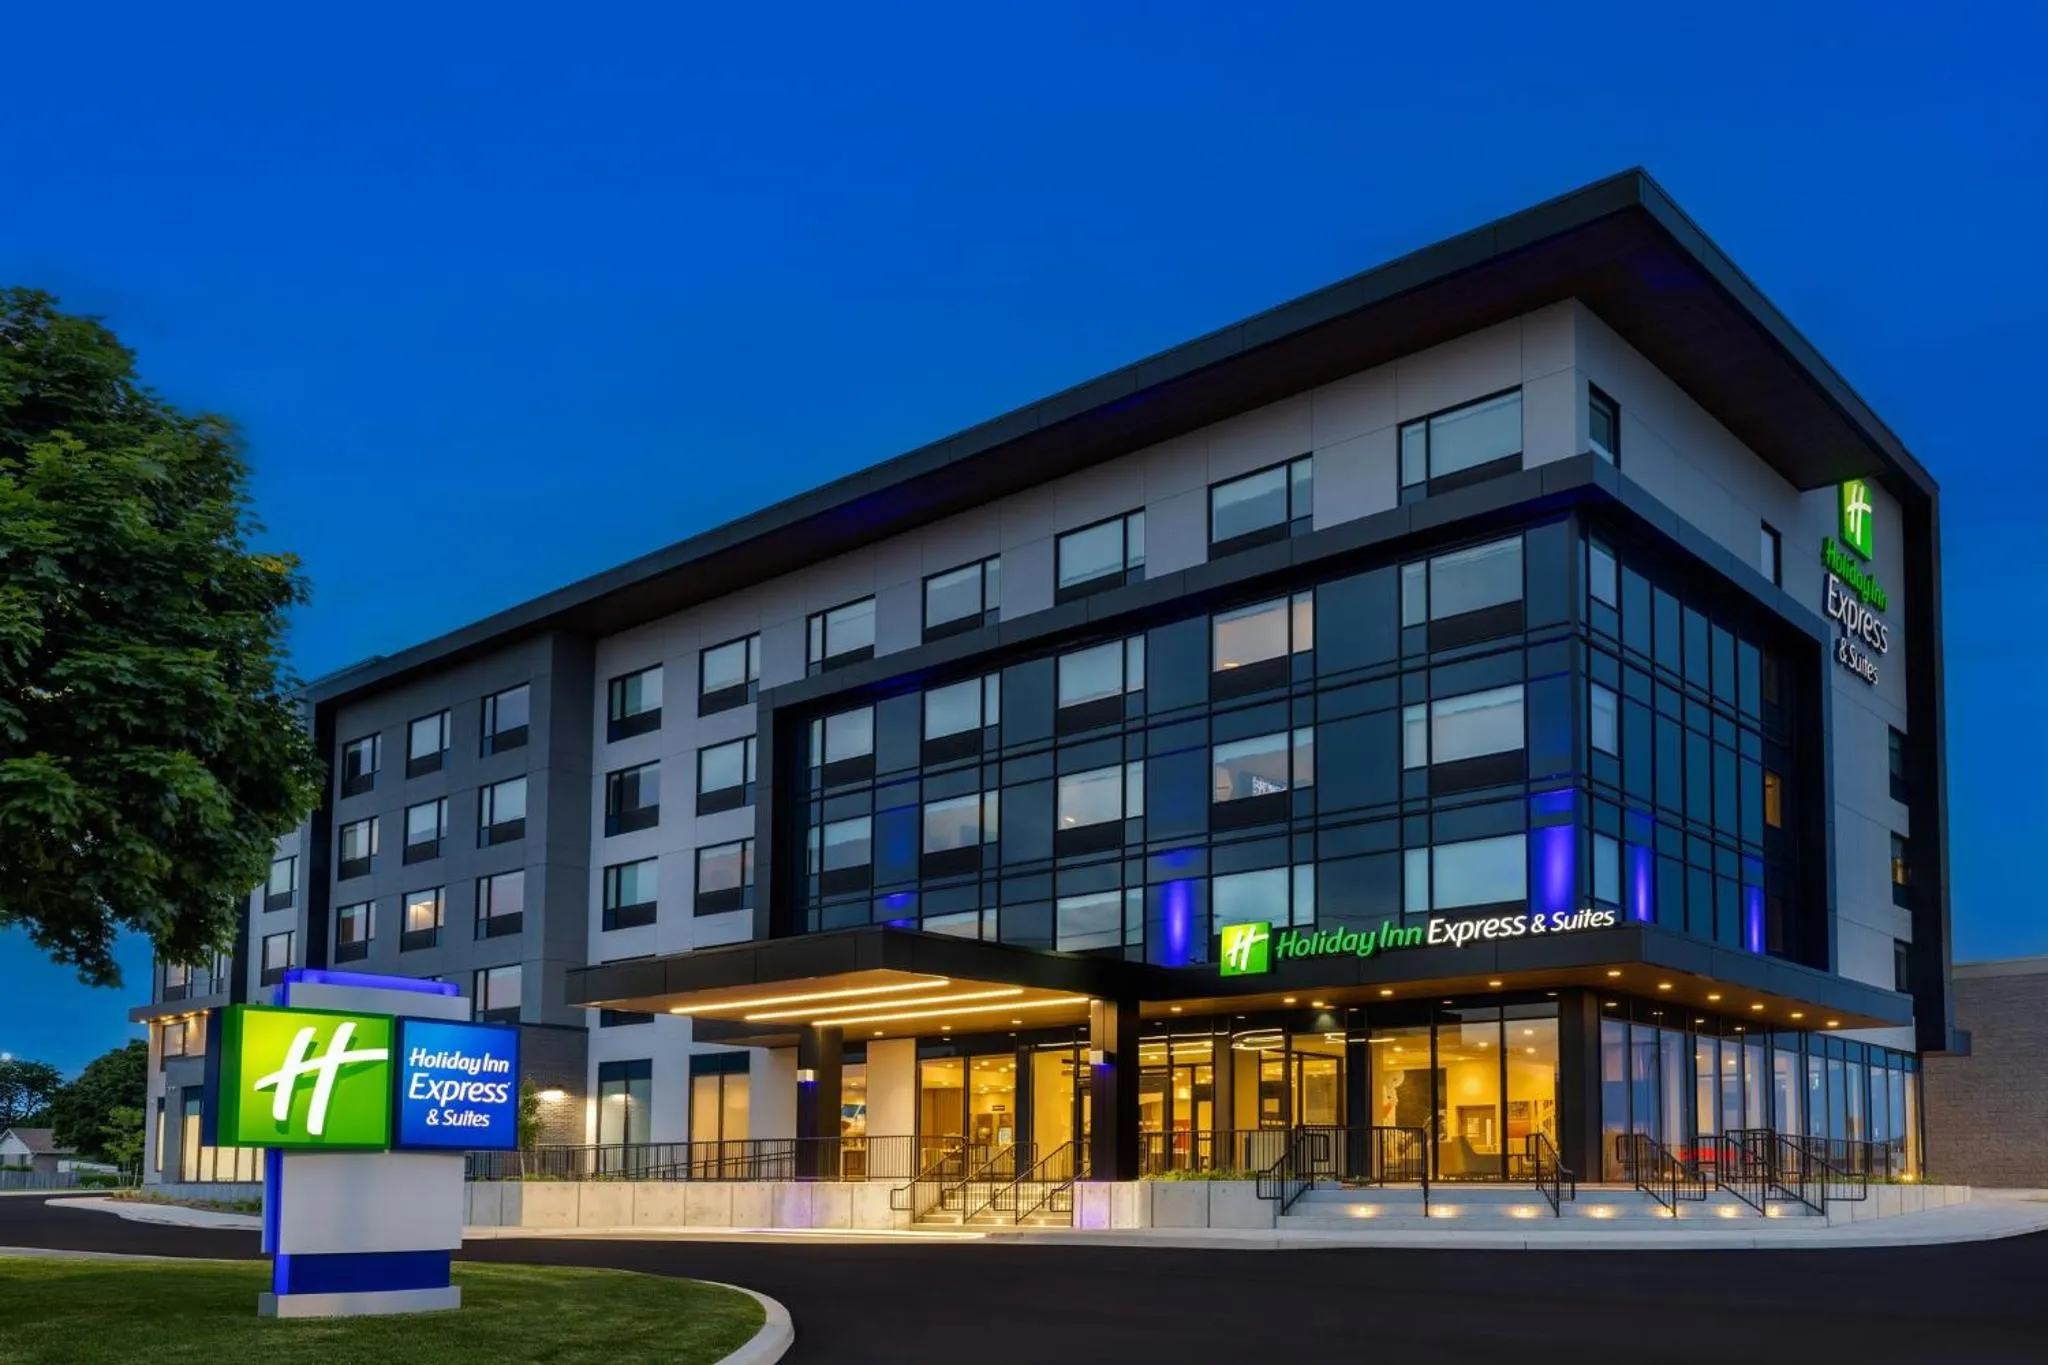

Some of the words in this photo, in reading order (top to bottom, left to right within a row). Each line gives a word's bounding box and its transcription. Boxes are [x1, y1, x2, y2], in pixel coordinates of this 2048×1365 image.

[1824, 536, 1870, 602] Holiday
[1870, 574, 1887, 612] Inn
[1827, 572, 1889, 654] Express
[1839, 637, 1847, 663] &
[1848, 644, 1879, 685] Suites
[1275, 926, 1376, 957] Holiday
[1380, 920, 1422, 948] Inn
[1427, 915, 1528, 948] Express
[1530, 914, 1546, 933] &
[1551, 908, 1616, 932] Suites
[408, 1047, 482, 1076] Holiday
[482, 1052, 510, 1073] Inn
[408, 1072, 510, 1108] Express
[426, 1108, 440, 1126] &
[442, 1109, 491, 1127] Suites
